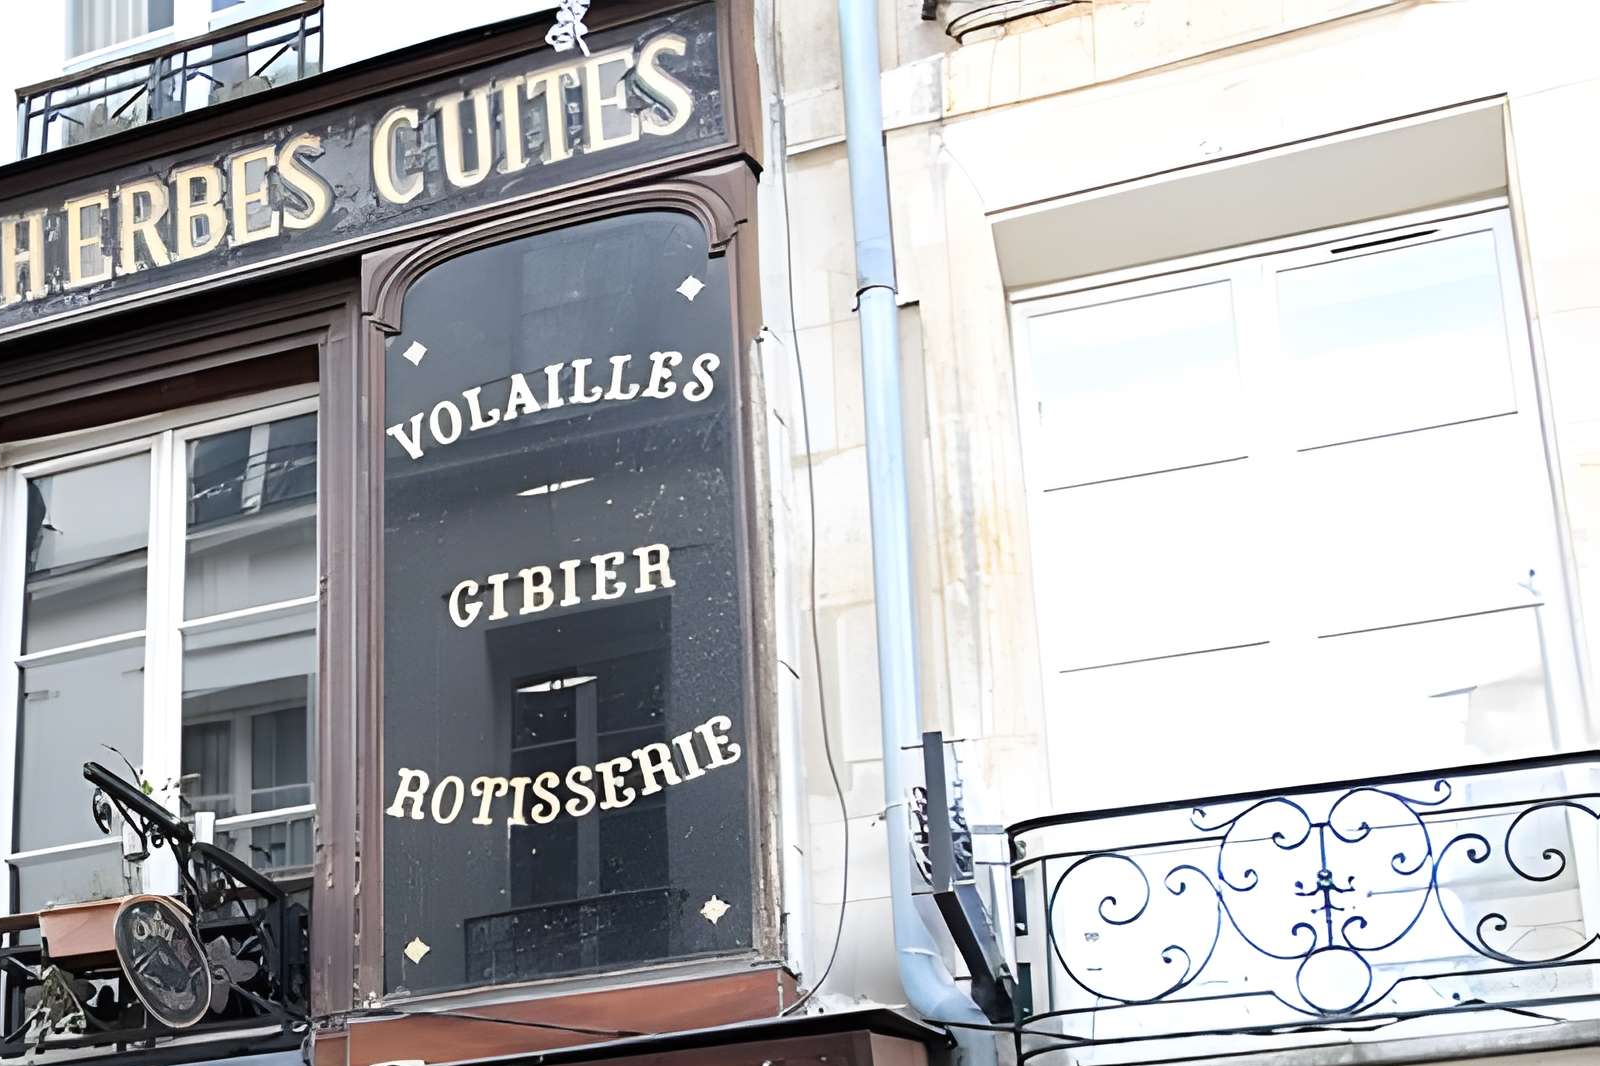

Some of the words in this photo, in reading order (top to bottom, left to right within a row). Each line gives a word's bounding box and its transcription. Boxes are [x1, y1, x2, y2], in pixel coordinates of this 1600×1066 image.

[372, 33, 695, 205] CUITES
[386, 350, 721, 460] VOLAILLES
[448, 543, 677, 628] GIBIER
[385, 715, 742, 826] ROTISSERIE
